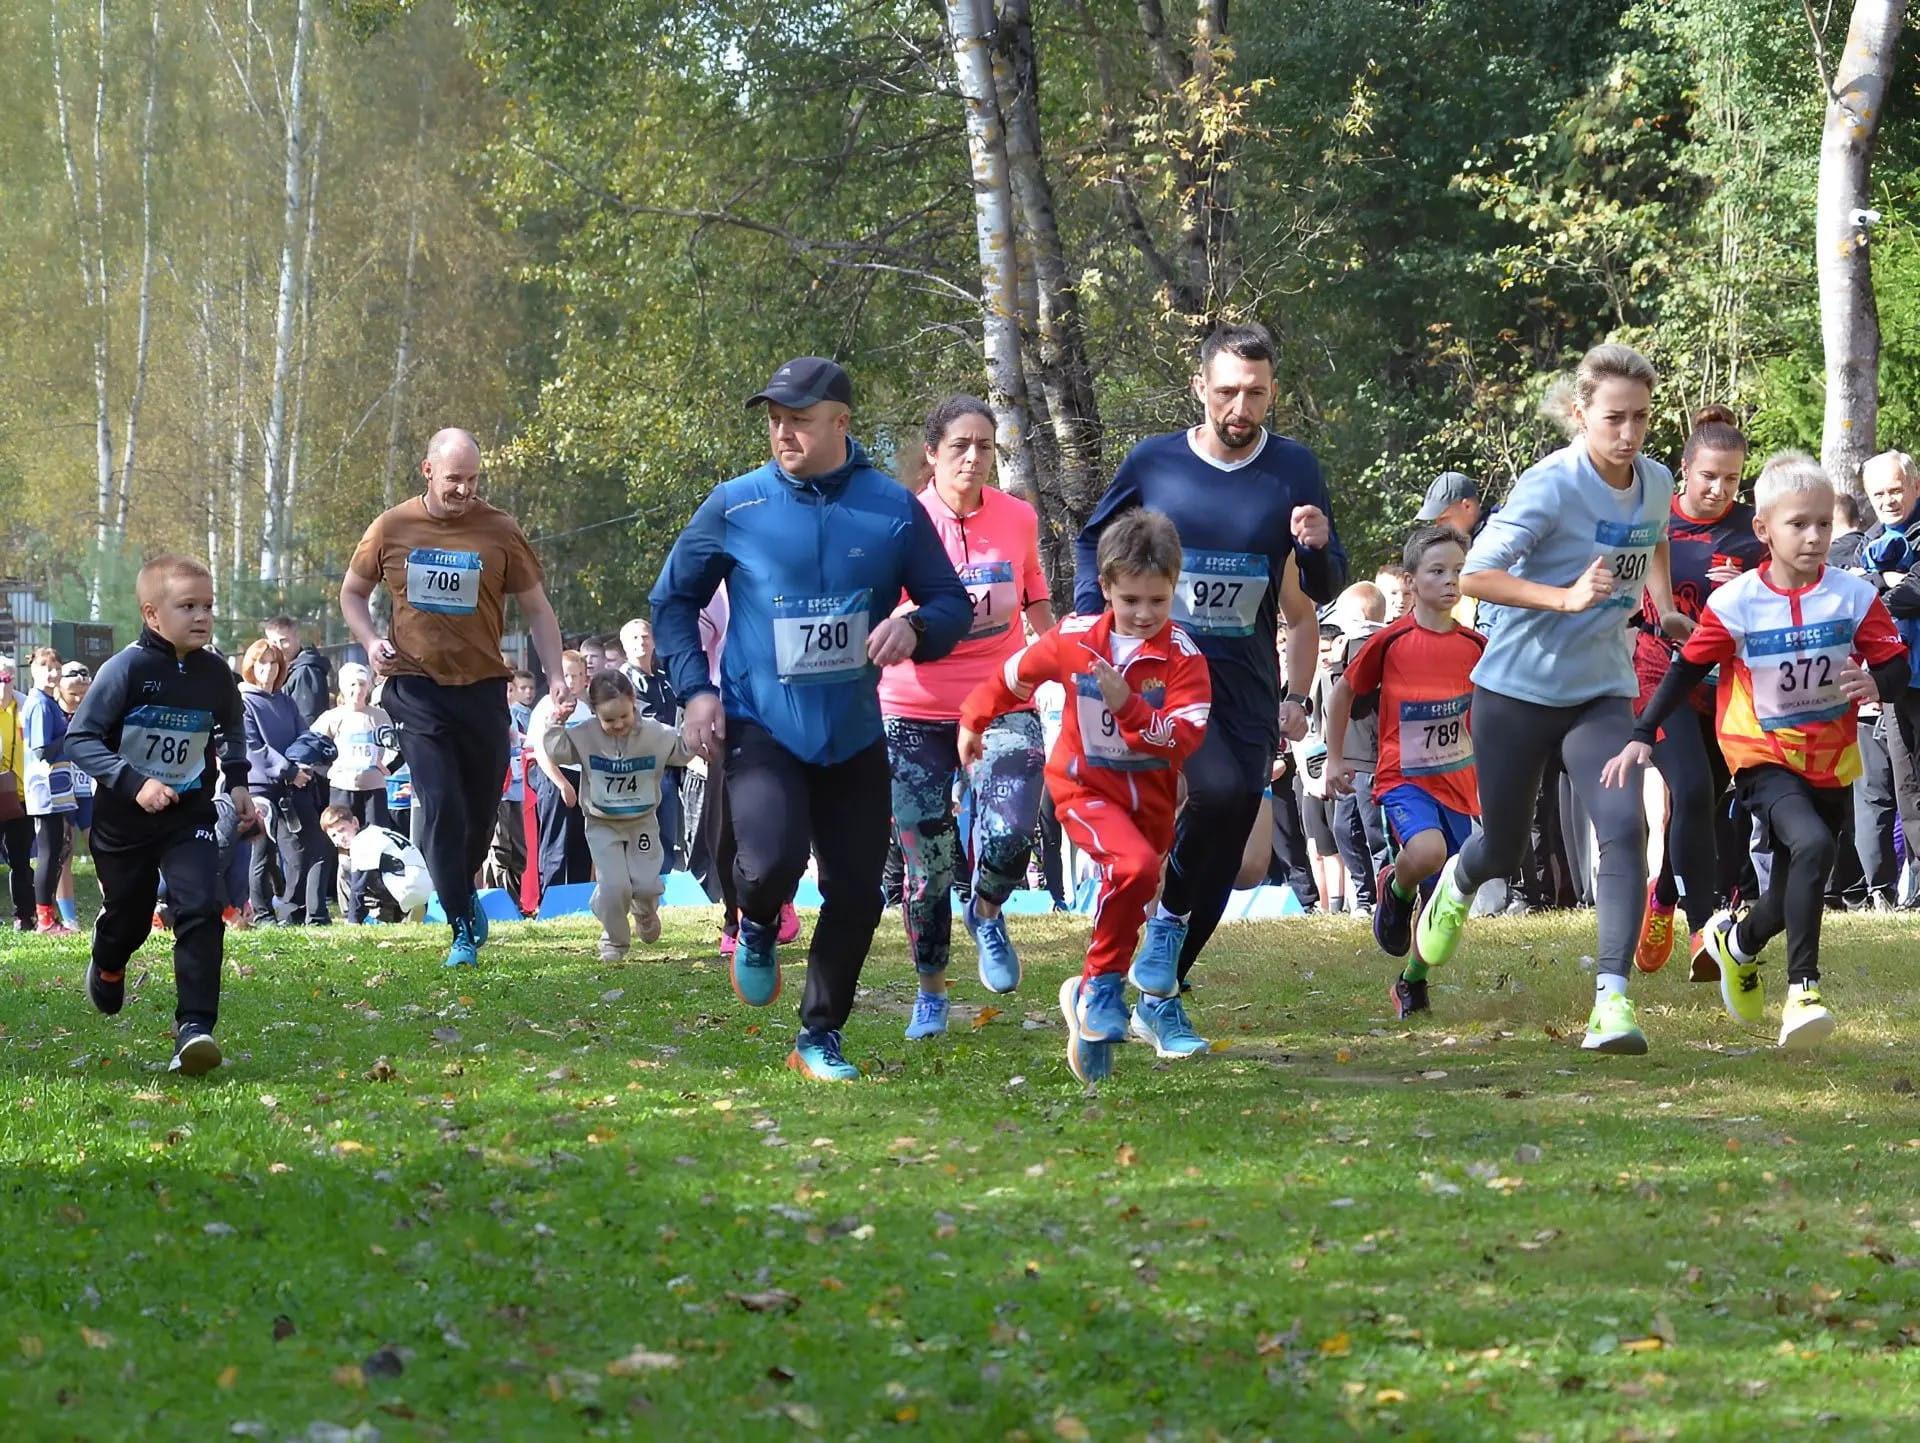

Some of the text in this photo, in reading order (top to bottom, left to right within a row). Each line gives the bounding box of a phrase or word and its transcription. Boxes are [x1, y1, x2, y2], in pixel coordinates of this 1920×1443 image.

[427, 570, 460, 592] 708
[1614, 553, 1647, 581] 390
[1194, 580, 1243, 608] 927
[800, 621, 848, 653] 780
[1779, 655, 1833, 692] 372
[1423, 720, 1460, 749] 789
[146, 734, 190, 765] 786
[605, 775, 638, 794] 774
